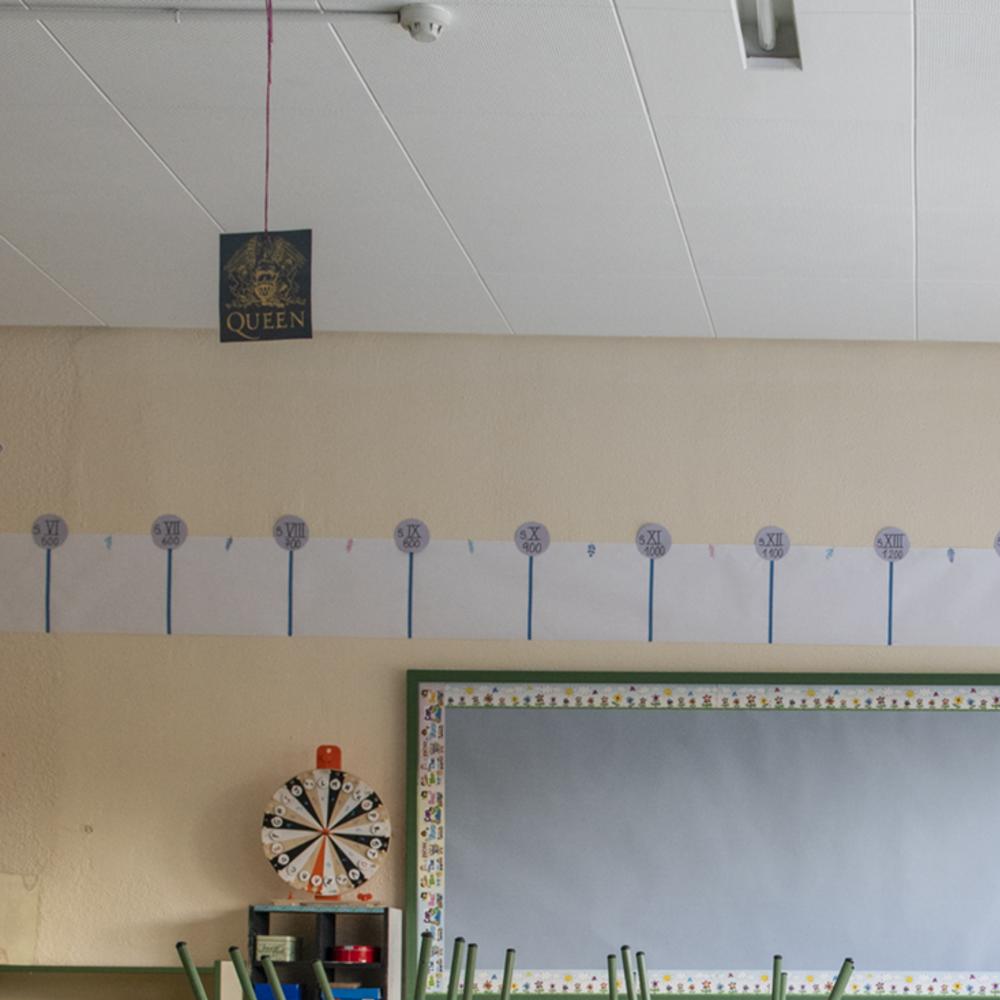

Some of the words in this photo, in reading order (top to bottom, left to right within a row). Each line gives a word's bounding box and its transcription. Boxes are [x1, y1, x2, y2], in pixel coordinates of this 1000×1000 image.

[226, 311, 305, 340] QUEEN
[523, 542, 541, 553] 900
[644, 546, 665, 556] 1000
